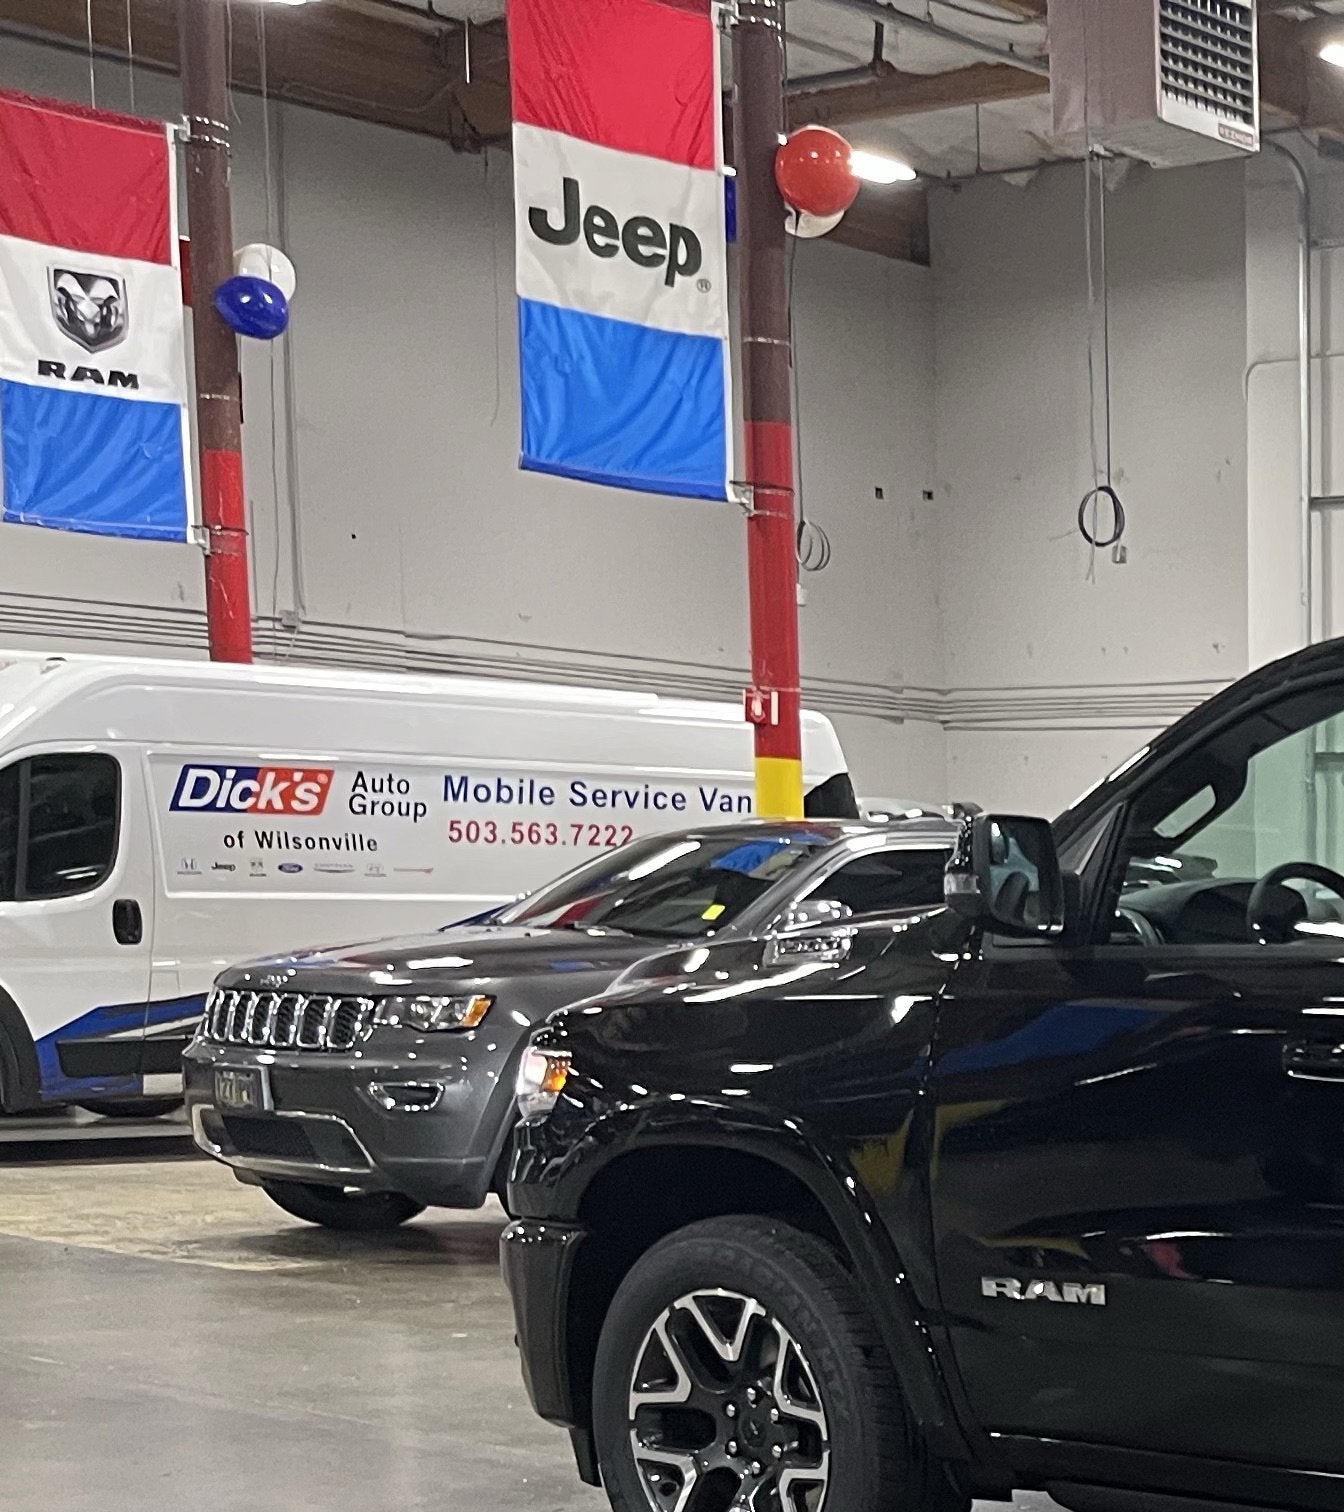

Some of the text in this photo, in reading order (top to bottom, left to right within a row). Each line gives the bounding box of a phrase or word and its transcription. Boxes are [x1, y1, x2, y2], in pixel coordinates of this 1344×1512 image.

[528, 177, 702, 287] Jeep
[38, 359, 139, 390] RAM
[178, 768, 322, 812] Dick's
[351, 771, 411, 795] Auto
[442, 775, 752, 813] Mobile Service Van
[349, 793, 428, 823] Group
[223, 830, 378, 851] of Wilsonville
[448, 820, 634, 847] 503.563.7222
[981, 1276, 1106, 1306] RAM
